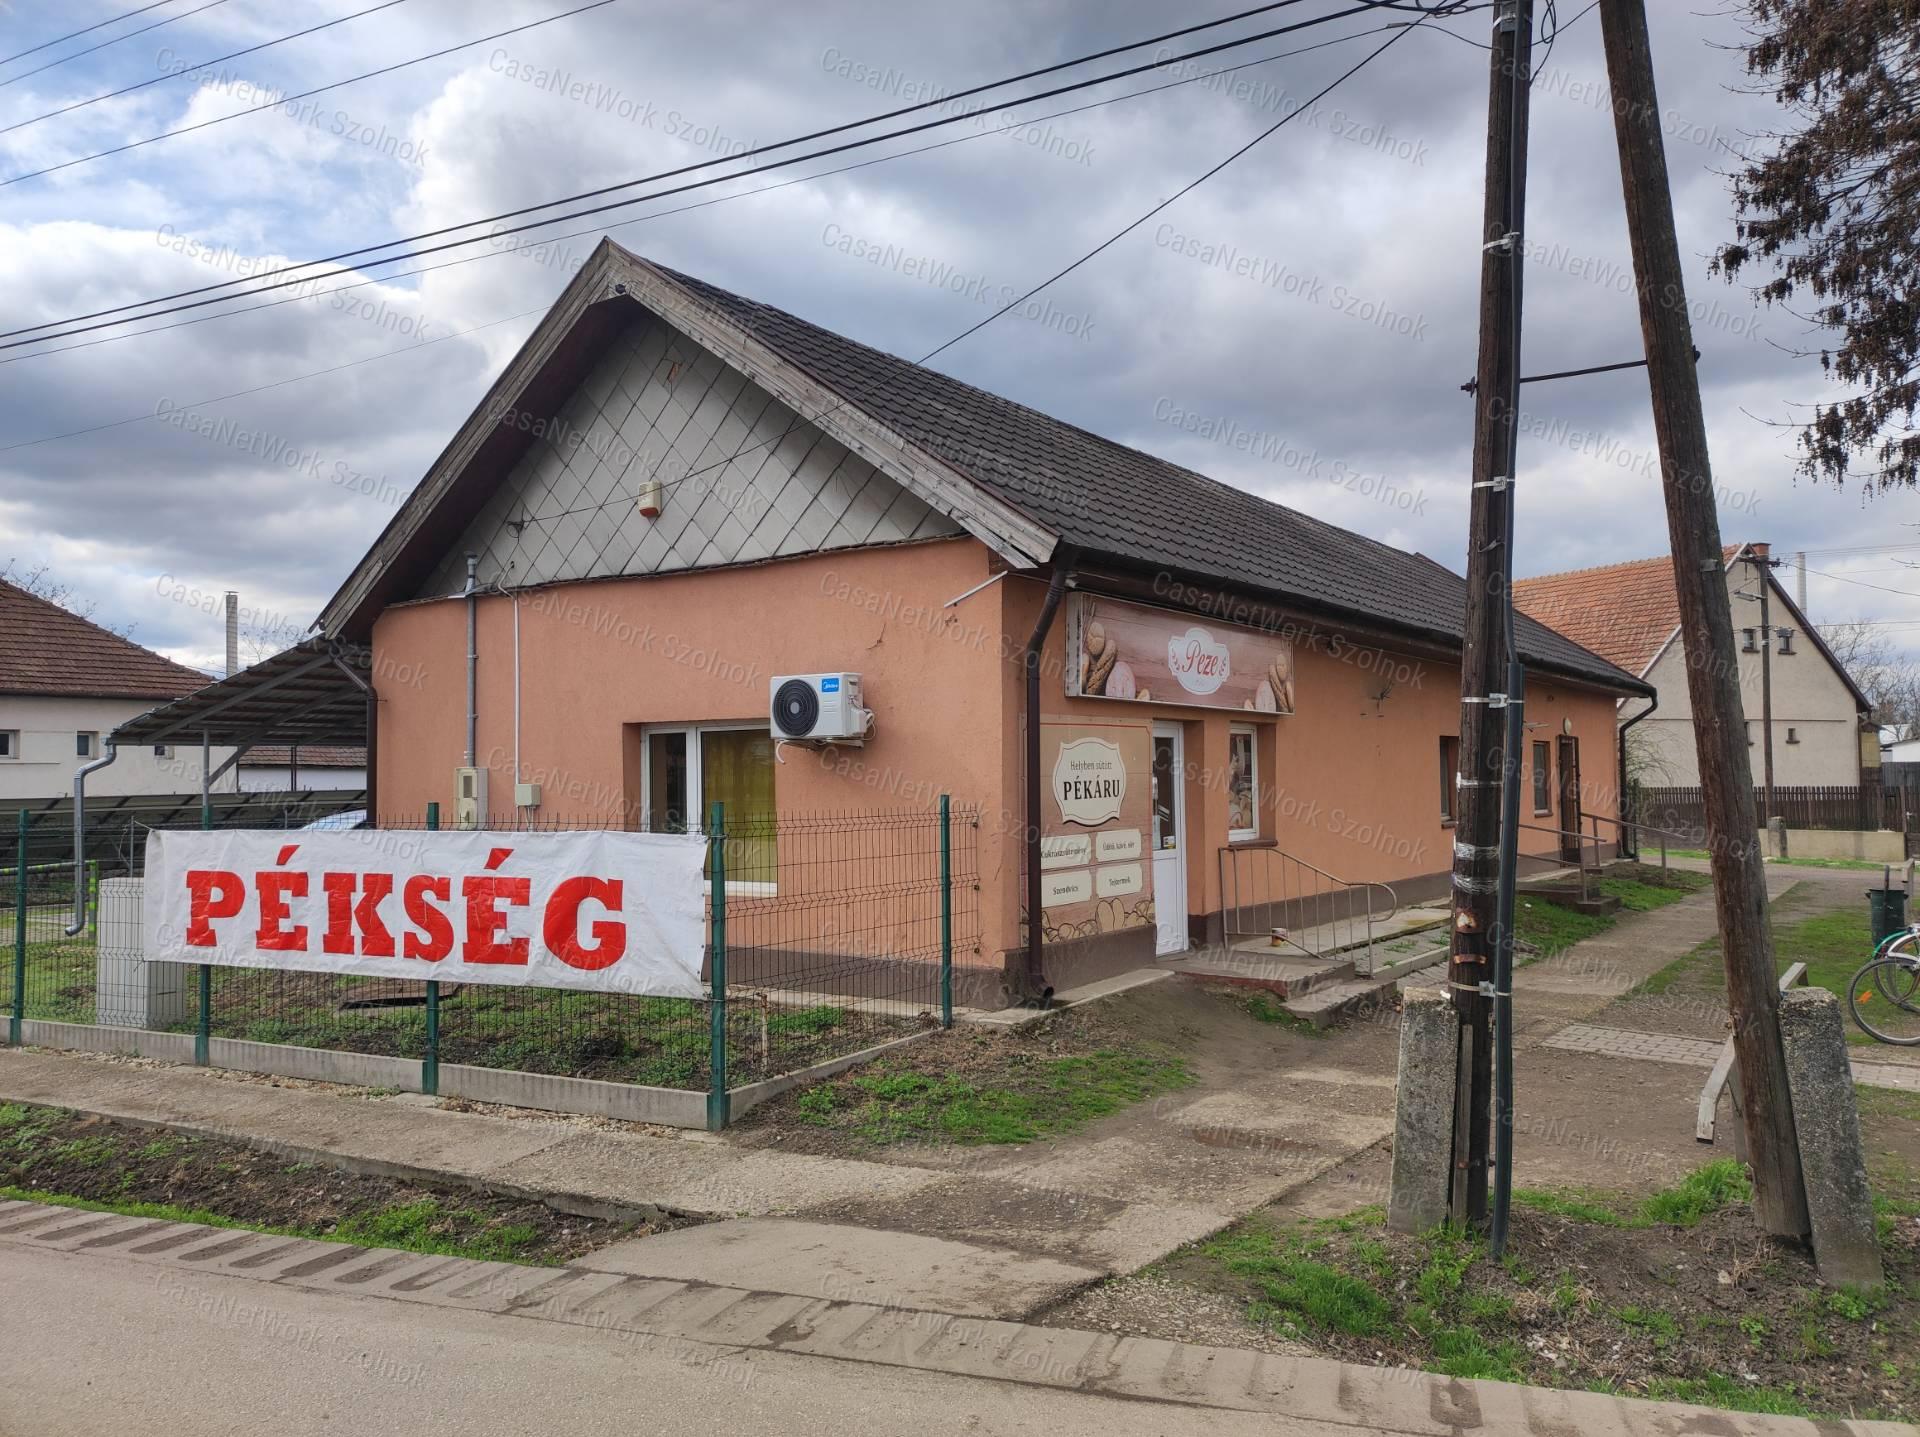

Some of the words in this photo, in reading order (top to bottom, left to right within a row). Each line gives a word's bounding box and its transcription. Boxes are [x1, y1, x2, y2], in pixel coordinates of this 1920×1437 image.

[1182, 640, 1219, 676] Peze
[1063, 775, 1120, 800] PÉKÁRU
[186, 845, 626, 971] PÉKSÉG
